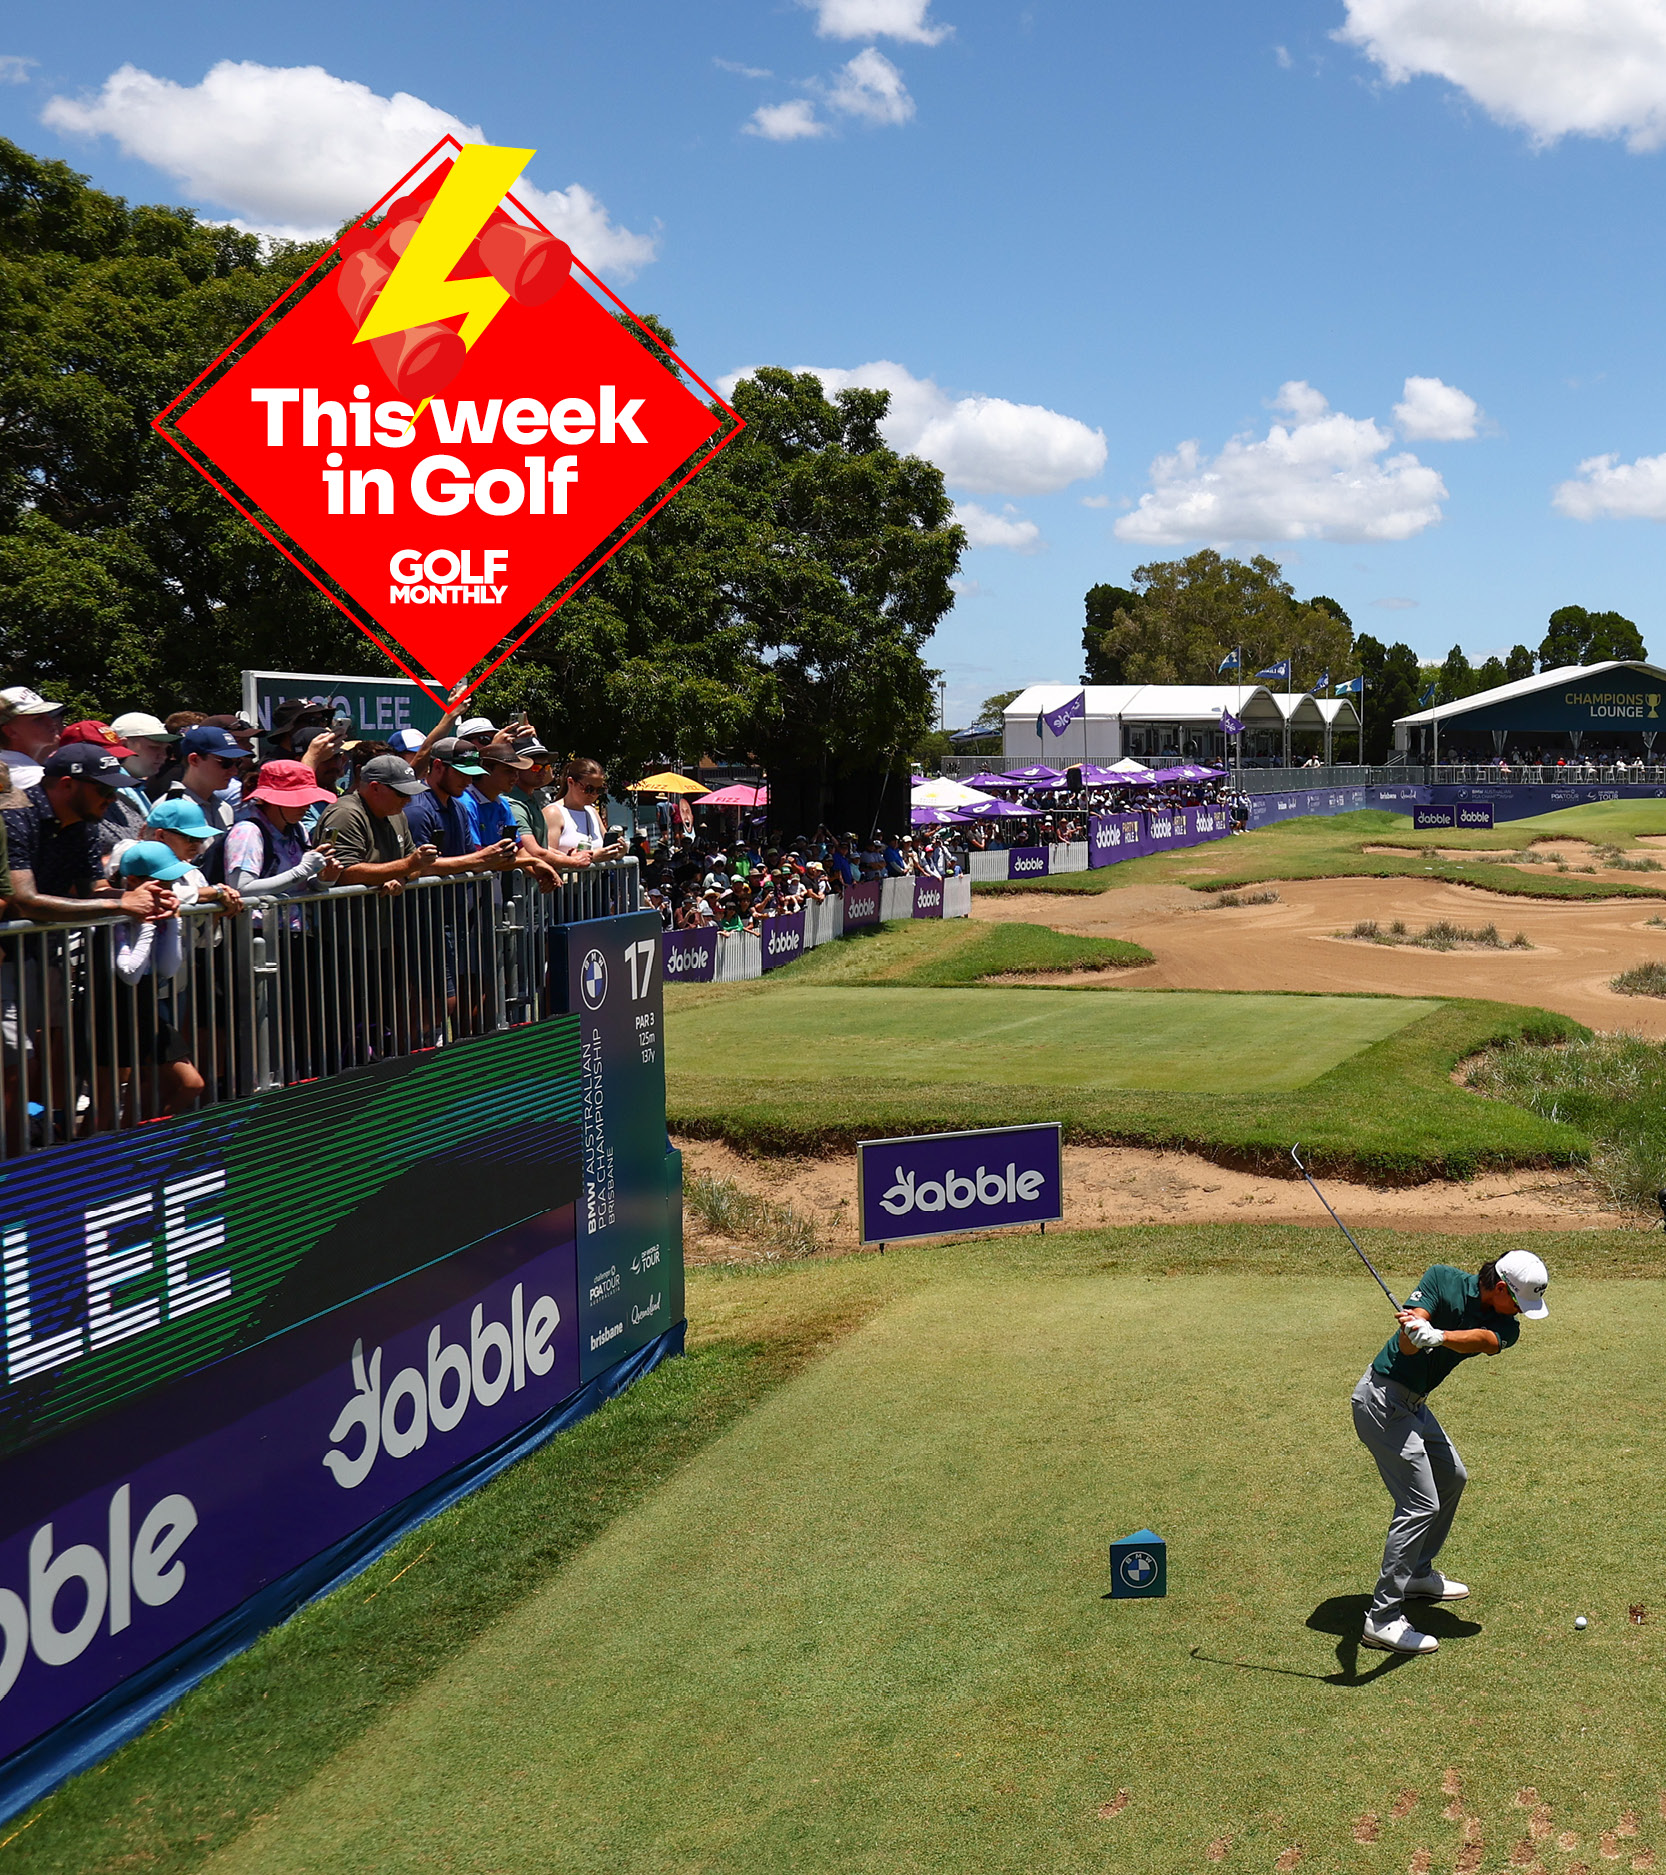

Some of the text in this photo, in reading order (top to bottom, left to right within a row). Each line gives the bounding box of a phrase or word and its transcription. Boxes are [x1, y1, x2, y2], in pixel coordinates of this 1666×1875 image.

[359, 696, 412, 731] LEE
[1565, 693, 1644, 706] CHAMPIONS
[1590, 706, 1644, 718] LOUNGE
[1418, 811, 1451, 825] dabble
[1460, 808, 1490, 823] dabble
[1096, 821, 1121, 849] dabble
[1014, 856, 1044, 872] dabble
[848, 896, 876, 919] dabble
[917, 886, 941, 909] dabble
[767, 928, 800, 956] dabble
[624, 938, 656, 1001] 17
[667, 944, 709, 974] dabble
[635, 1012, 655, 1030] PAR 3
[639, 1031, 656, 1046] 125m
[641, 1049, 656, 1064] 137y
[582, 1043, 597, 1235] BMW AUSTRALIAN
[592, 1028, 607, 1230] PGA CHAMPIONSHIP
[606, 1146, 616, 1224] BRISBANE
[879, 1165, 1046, 1216] dabble
[641, 1251, 660, 1272] TOUR
[3, 1168, 232, 1385] LEE
[590, 1322, 624, 1352] brisbane
[322, 1282, 561, 1489] dabble
